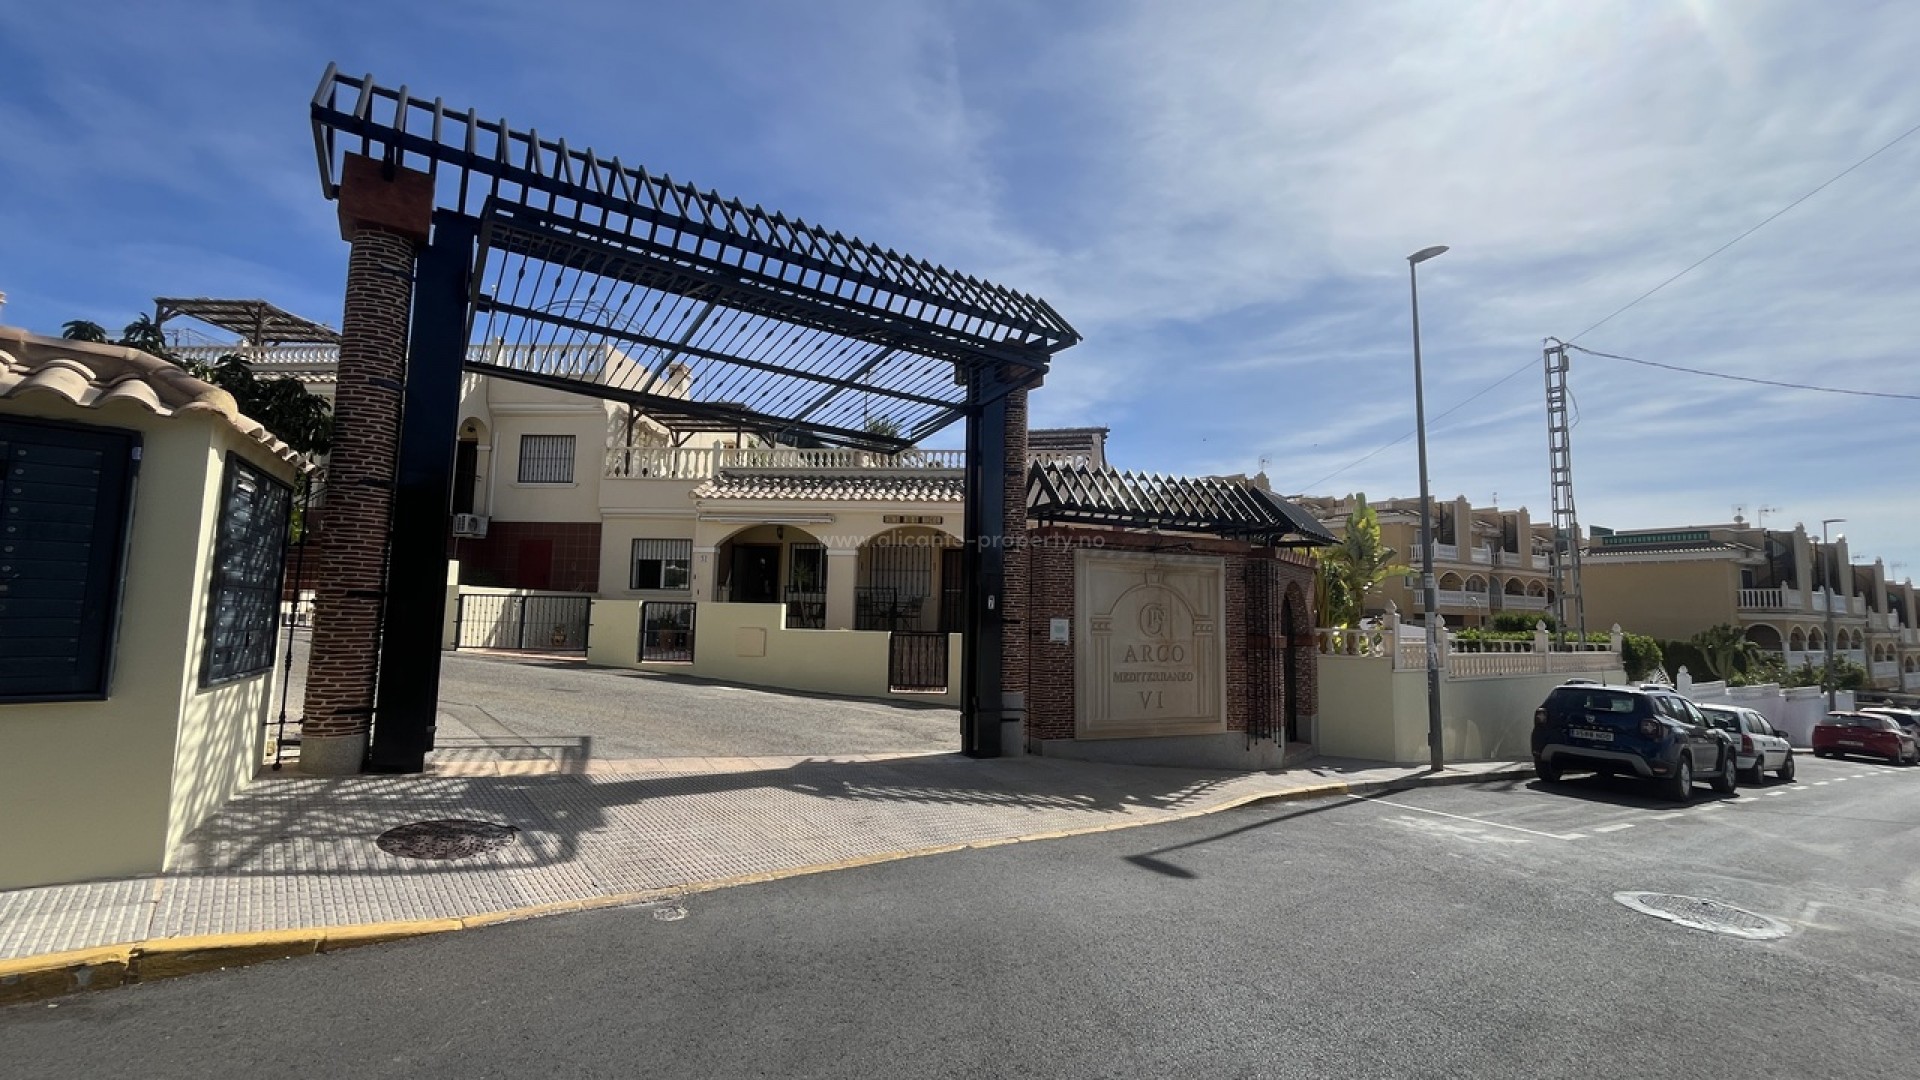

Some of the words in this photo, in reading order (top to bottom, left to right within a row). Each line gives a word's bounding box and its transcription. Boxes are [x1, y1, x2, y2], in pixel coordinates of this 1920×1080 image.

[1123, 645, 1184, 662] ARCO
[1113, 672, 1193, 682] MEDITERRANEO
[1138, 691, 1163, 709] VI
